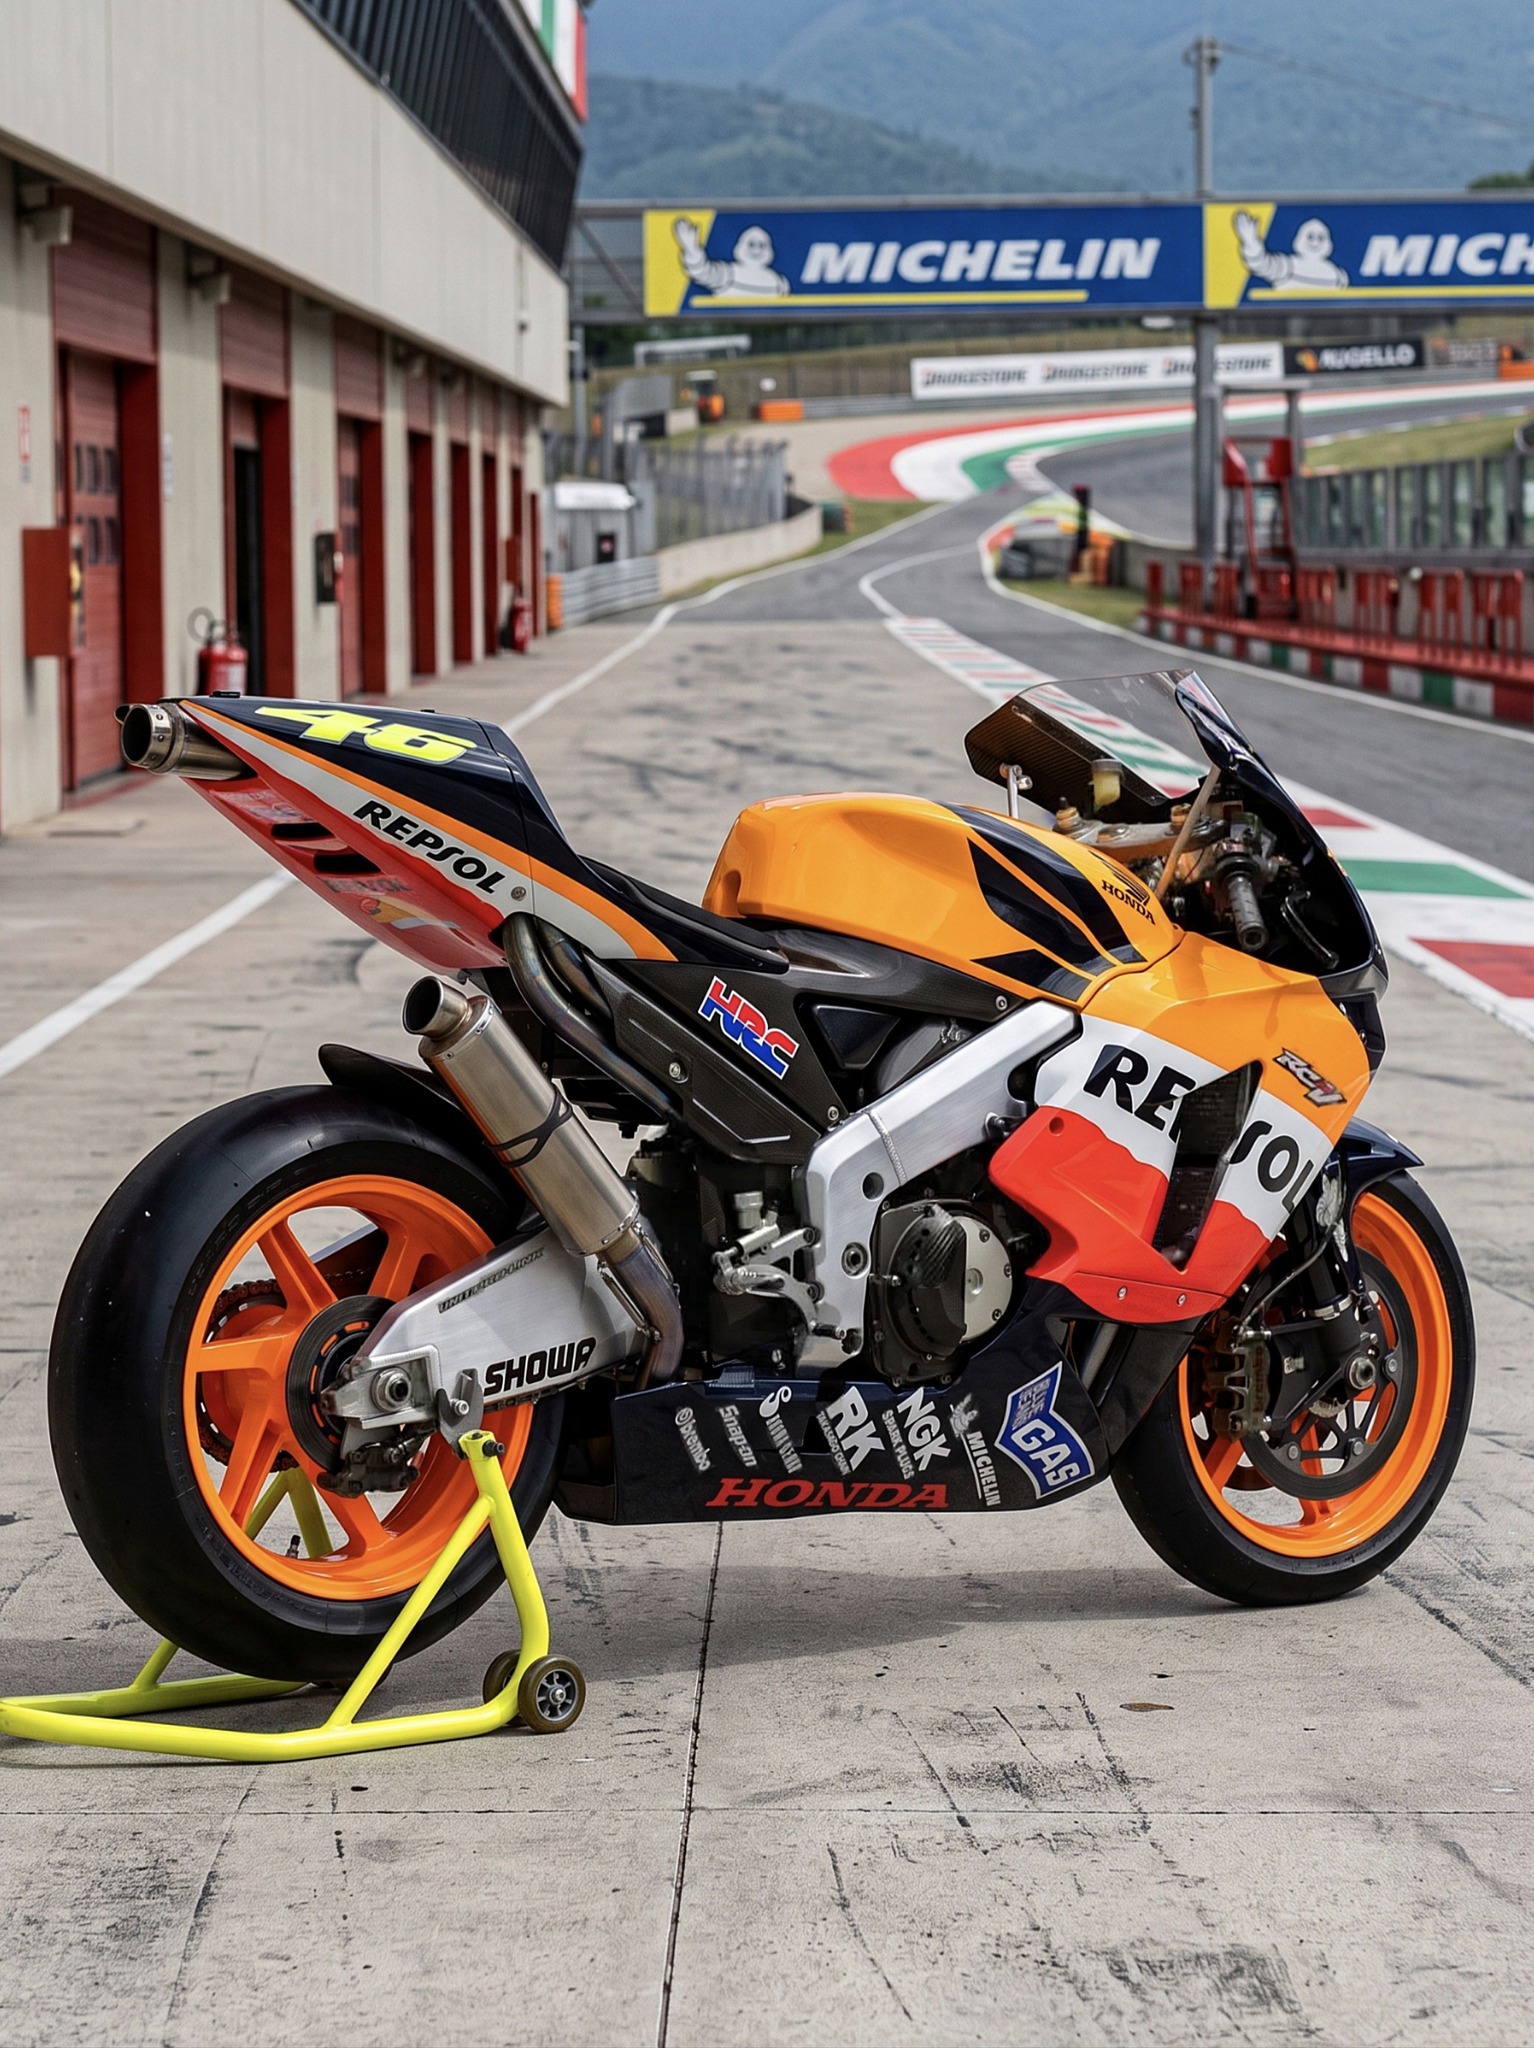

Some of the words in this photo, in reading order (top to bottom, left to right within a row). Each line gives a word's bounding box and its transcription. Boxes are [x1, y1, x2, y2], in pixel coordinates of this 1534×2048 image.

[800, 238, 1162, 284] MICHELIN
[254, 706, 477, 764] 46
[353, 800, 506, 894] REPSOL
[1101, 880, 1156, 926] HONDA
[698, 976, 799, 1080] HRC
[1083, 1044, 1314, 1214] RESOL
[484, 1337, 597, 1396] SHOWA
[679, 1418, 711, 1471] brembo
[813, 1409, 842, 1453] TAKASAGO
[825, 1385, 886, 1471] RK
[882, 1409, 901, 1447] SPARK
[895, 1444, 915, 1480] PLUGS
[897, 1386, 951, 1471] NGK
[1011, 1419, 1080, 1486] GAS
[705, 1478, 948, 1508] HONDA
[967, 1431, 1001, 1506] MICHELIN
